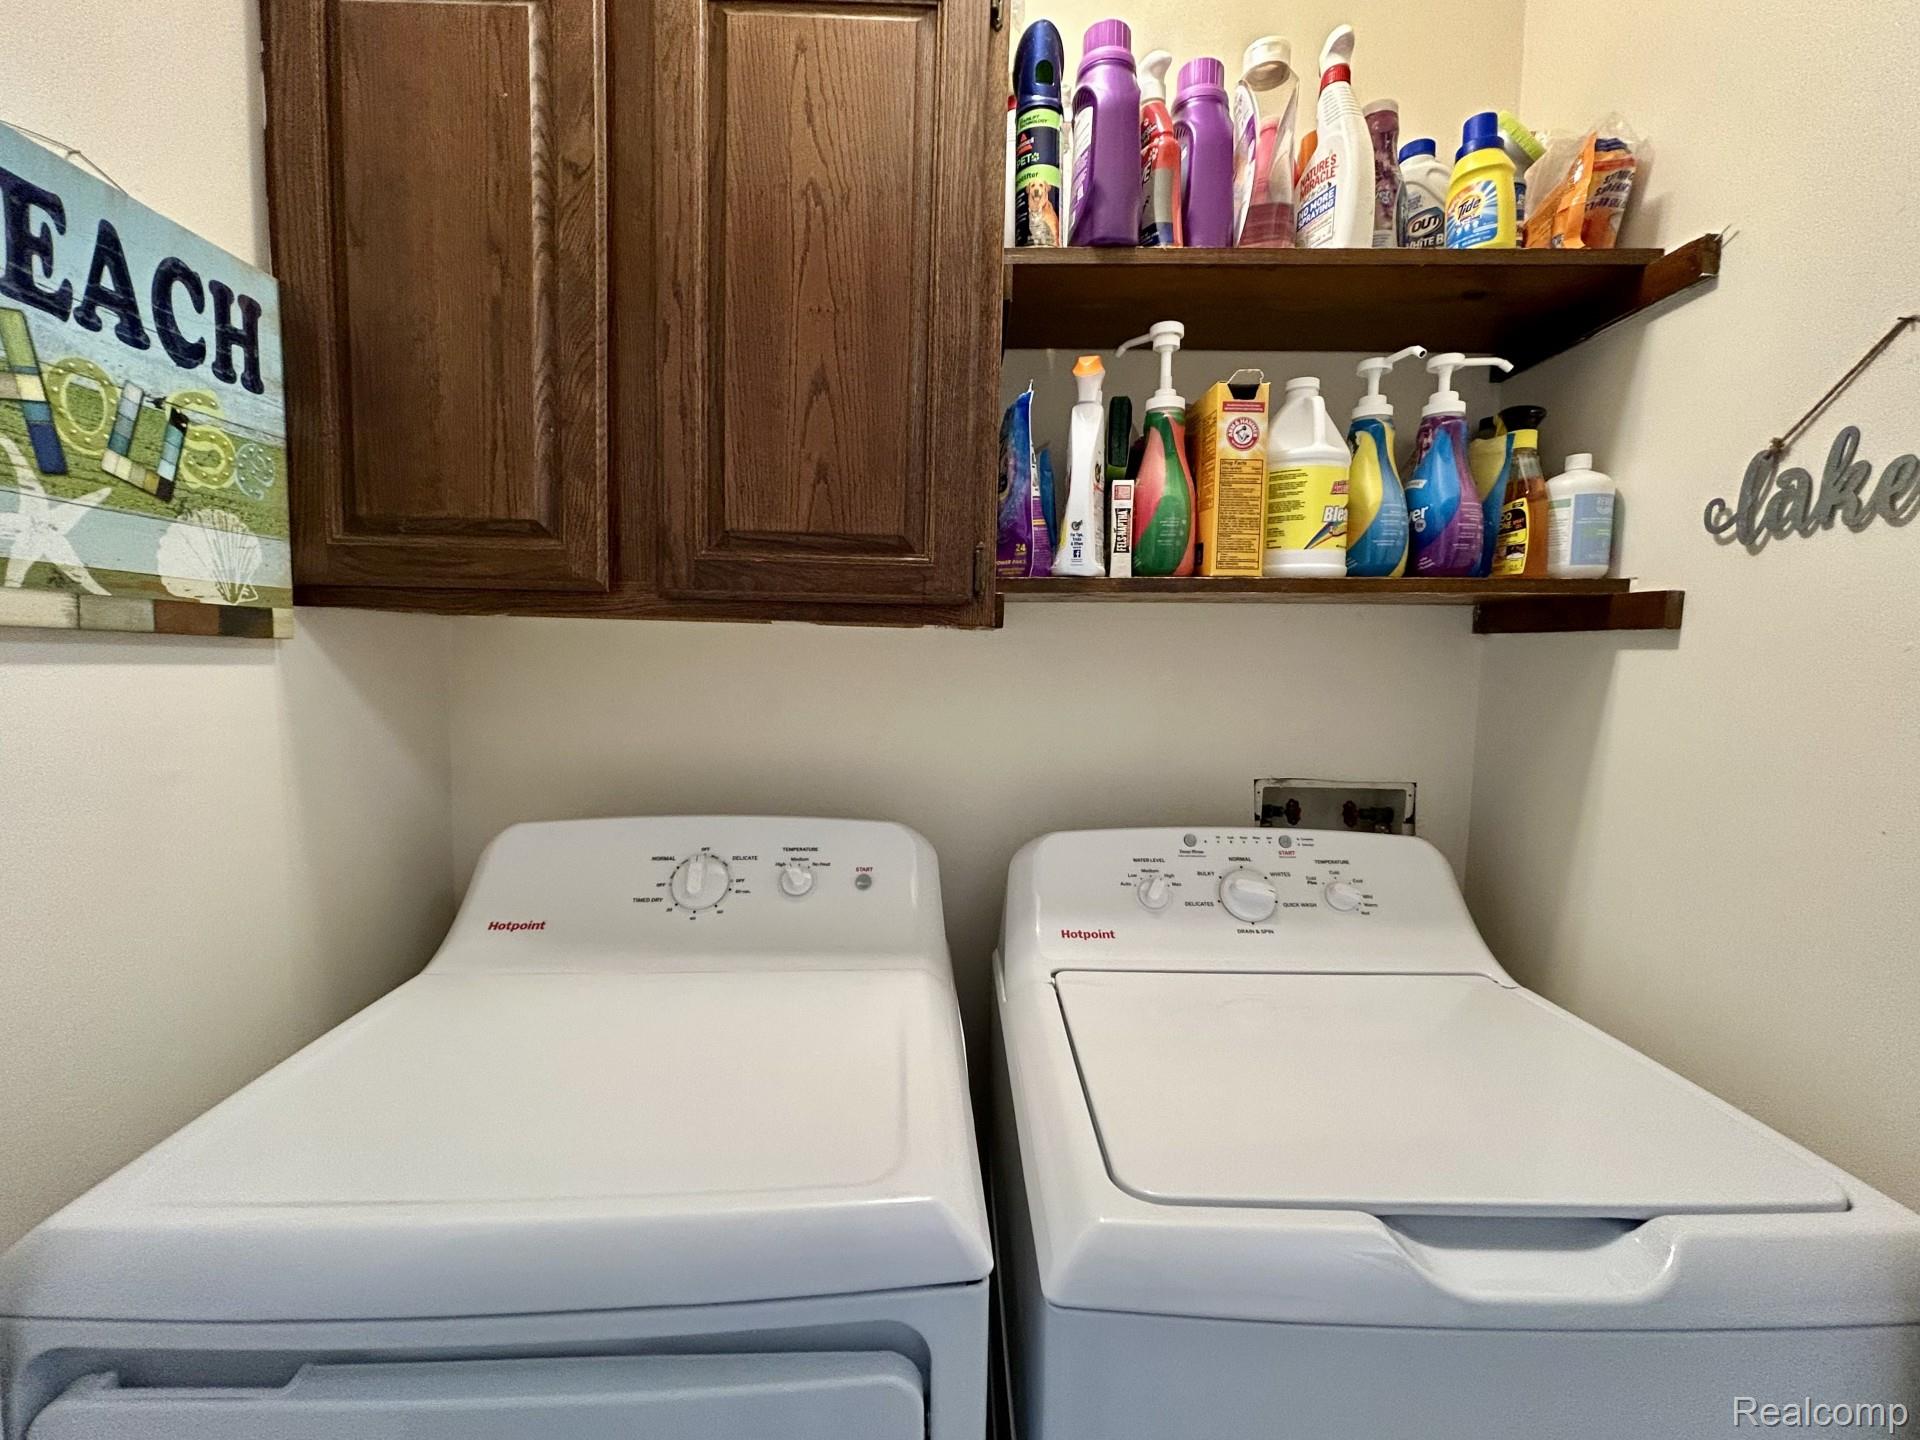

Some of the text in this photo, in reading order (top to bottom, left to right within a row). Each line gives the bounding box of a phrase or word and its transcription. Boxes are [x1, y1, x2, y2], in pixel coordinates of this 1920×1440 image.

[1309, 188, 1335, 213] MORE
[1458, 197, 1482, 220] Tide
[1411, 215, 1439, 234] OUT
[488, 920, 546, 932] Hotpoint
[1061, 929, 1116, 941] Hotpoint
